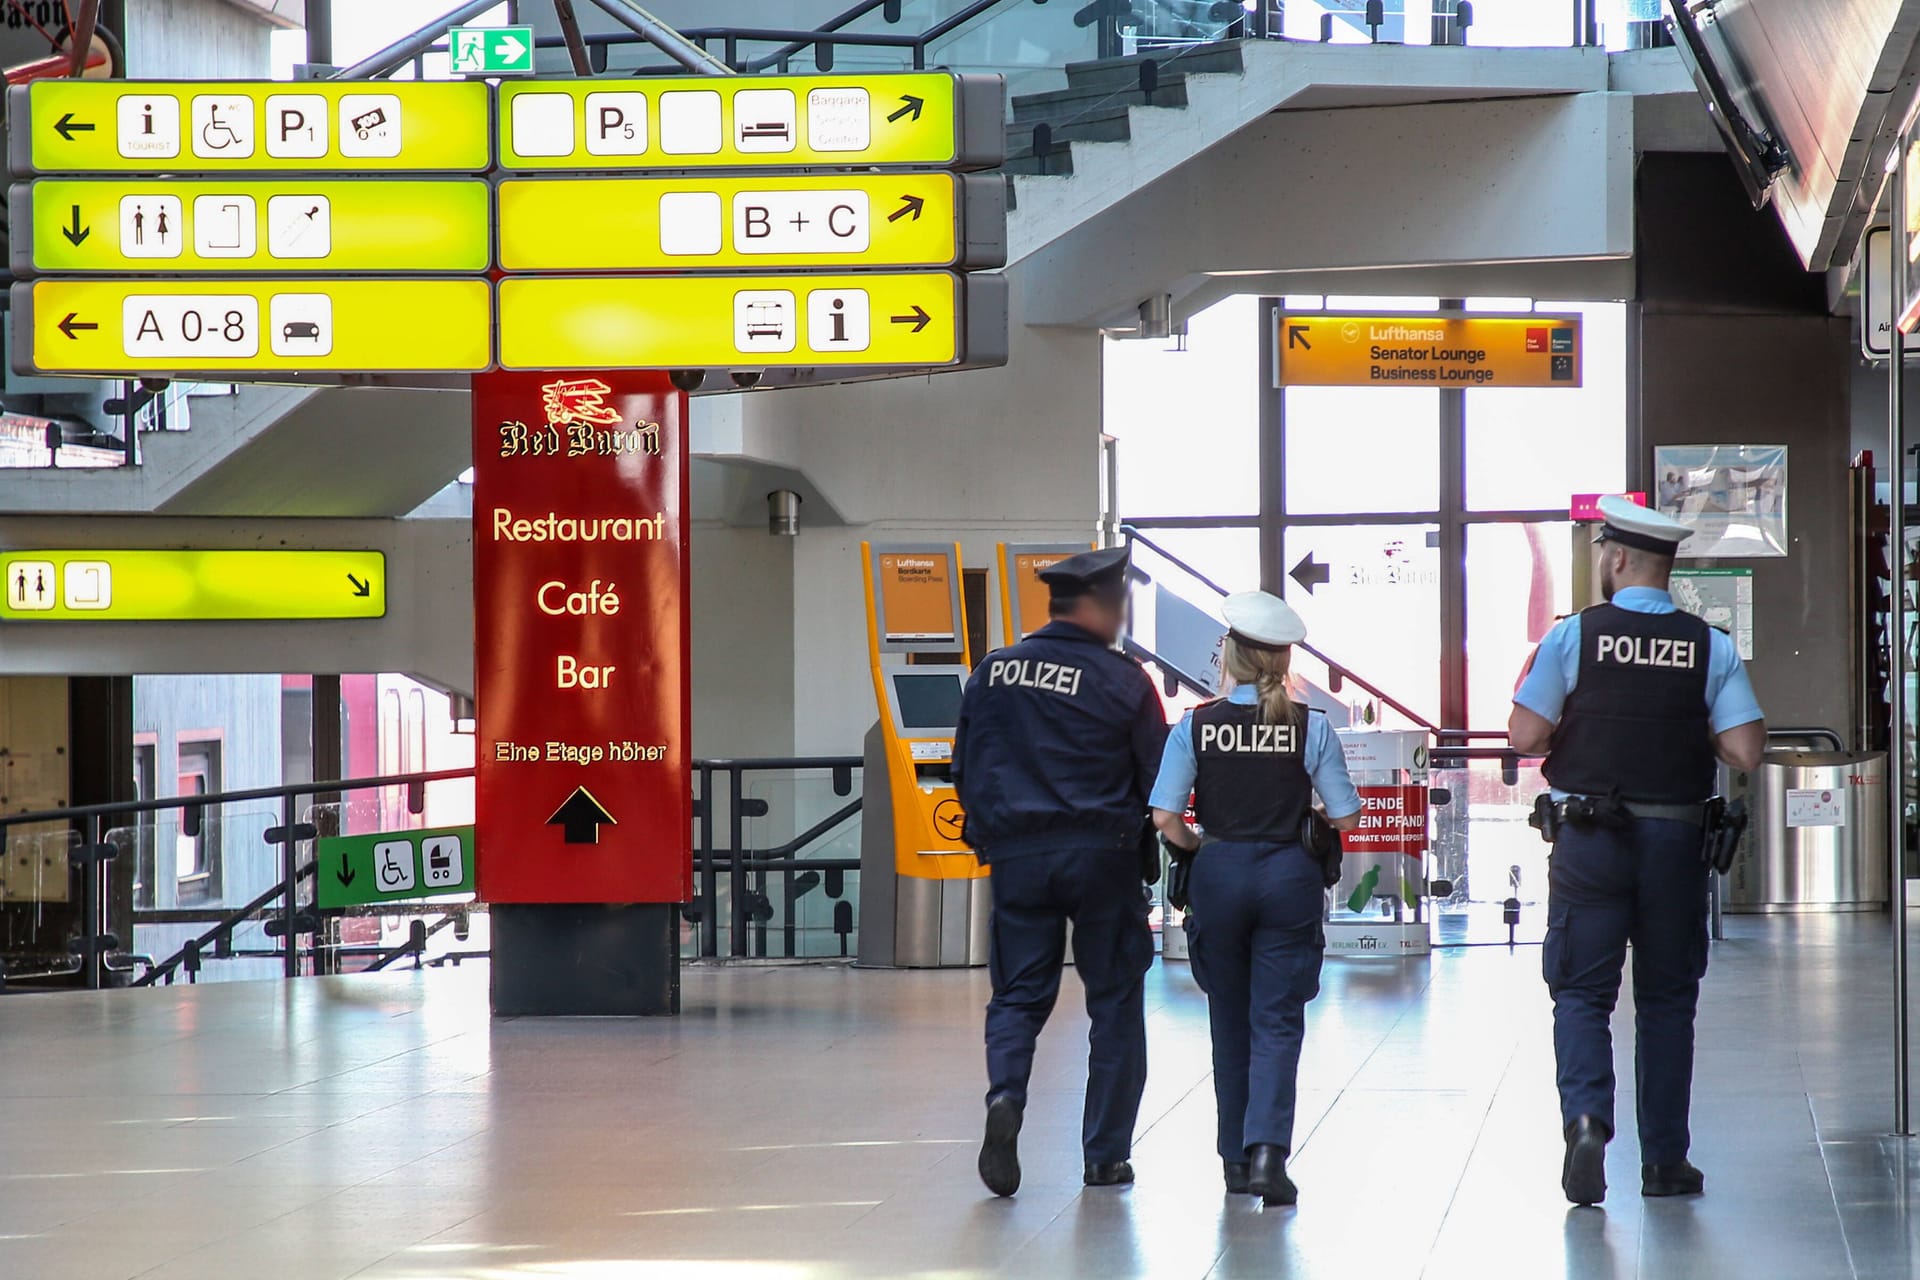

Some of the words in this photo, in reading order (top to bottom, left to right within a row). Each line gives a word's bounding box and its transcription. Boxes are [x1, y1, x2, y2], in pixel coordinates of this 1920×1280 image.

[0, 0, 68, 29] aron
[128, 141, 171, 150] TOURIST
[744, 206, 772, 239] B
[827, 204, 857, 238] C
[136, 310, 164, 341] A
[181, 310, 245, 342] 0-8
[1369, 326, 1444, 342] Lufthansa
[1370, 346, 1429, 360] Senator
[1432, 346, 1486, 363] Lounge
[1370, 366, 1436, 380] Business
[1439, 366, 1494, 382] Lounge
[499, 420, 560, 458] Red
[566, 419, 662, 458] Baron
[493, 507, 665, 542] Restaurant
[896, 558, 935, 568] Lufthansa
[537, 579, 620, 616] Café
[1597, 634, 1696, 669] POLIZEI
[557, 655, 616, 689] Bar
[988, 659, 1083, 696] POLIZEI
[1200, 723, 1297, 753] POLIZEI
[495, 741, 540, 762] Eine
[545, 741, 604, 766] Etage
[608, 741, 667, 761] höher
[1848, 775, 1866, 785] TXL
[1360, 797, 1404, 810] PENDE
[1358, 815, 1382, 828] EIN
[1386, 815, 1425, 828] PFAND!
[1348, 834, 1380, 843] DONATE
[1381, 834, 1401, 842] YOUR
